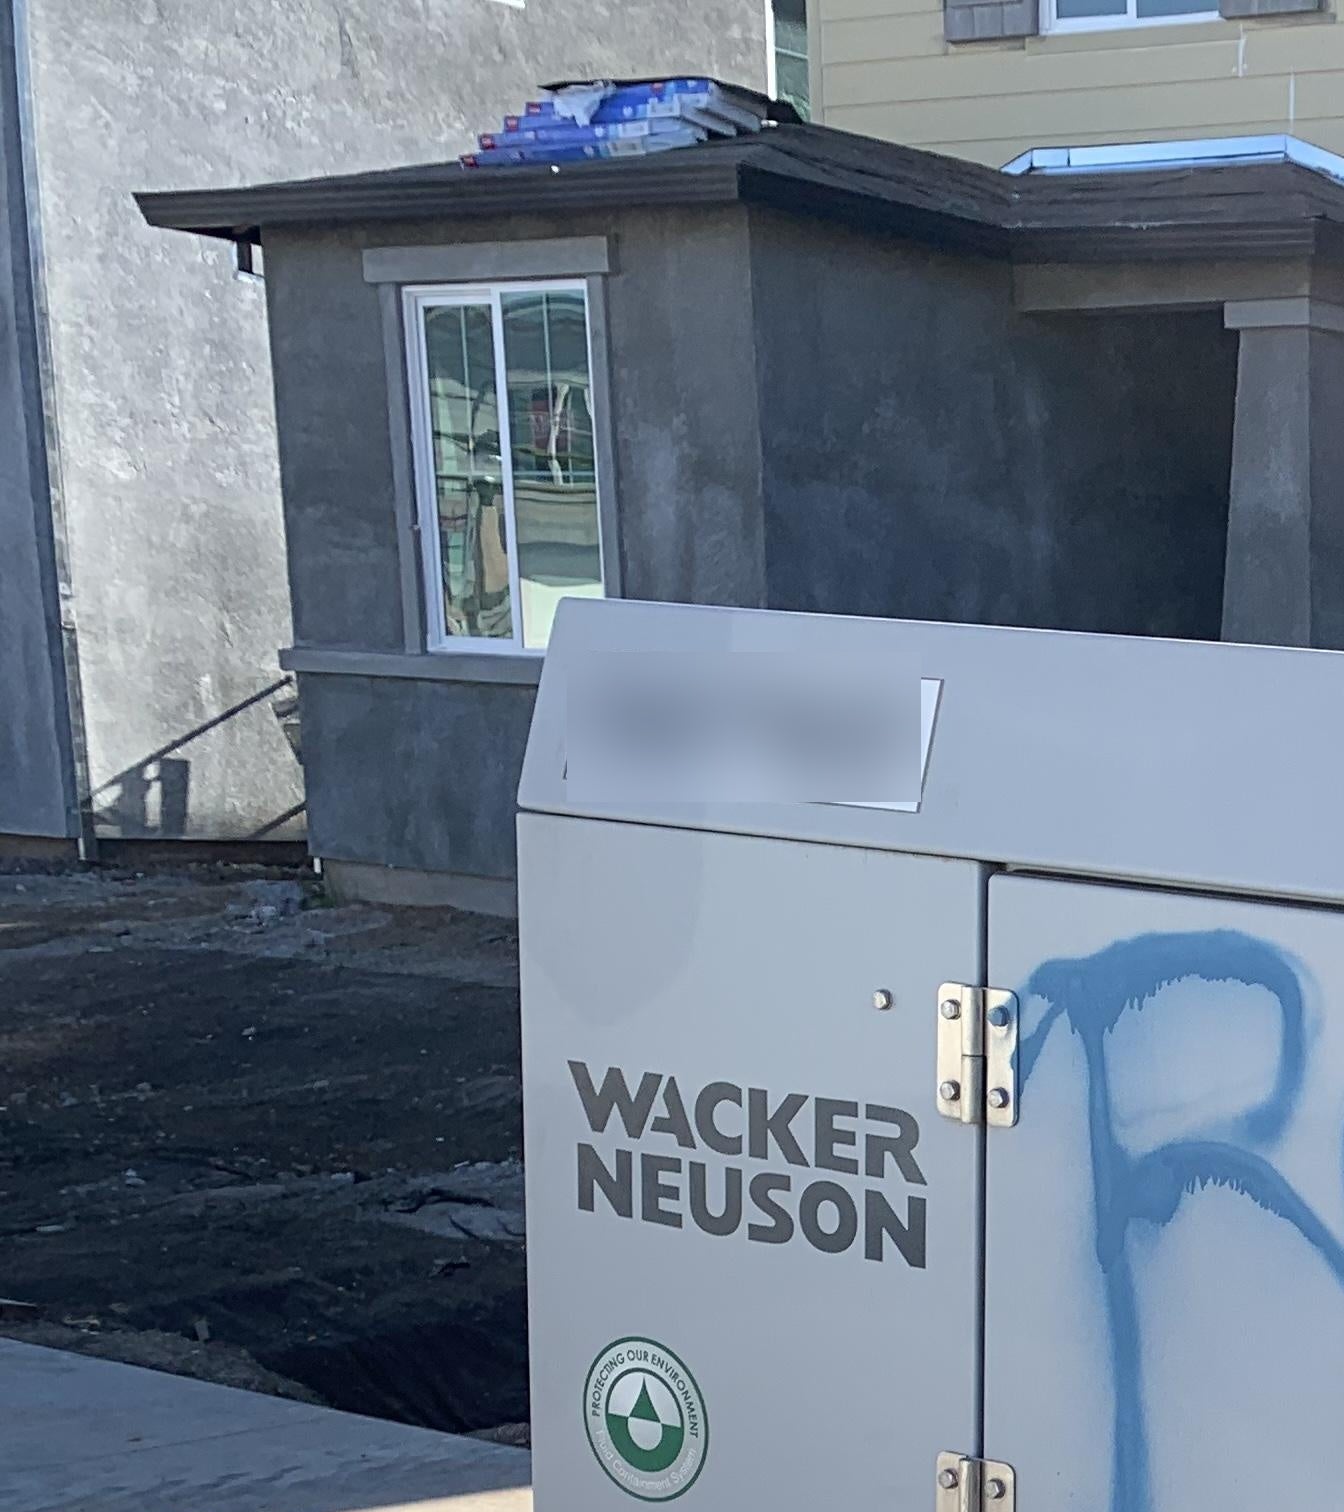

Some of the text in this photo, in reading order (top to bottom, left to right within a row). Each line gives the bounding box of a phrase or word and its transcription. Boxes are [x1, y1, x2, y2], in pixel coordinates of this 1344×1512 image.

[567, 1060, 928, 1186] WACKER
[577, 1142, 927, 1269] NEUSON
[592, 1349, 699, 1438] PROTECTING OUR ENVIRONMENT
